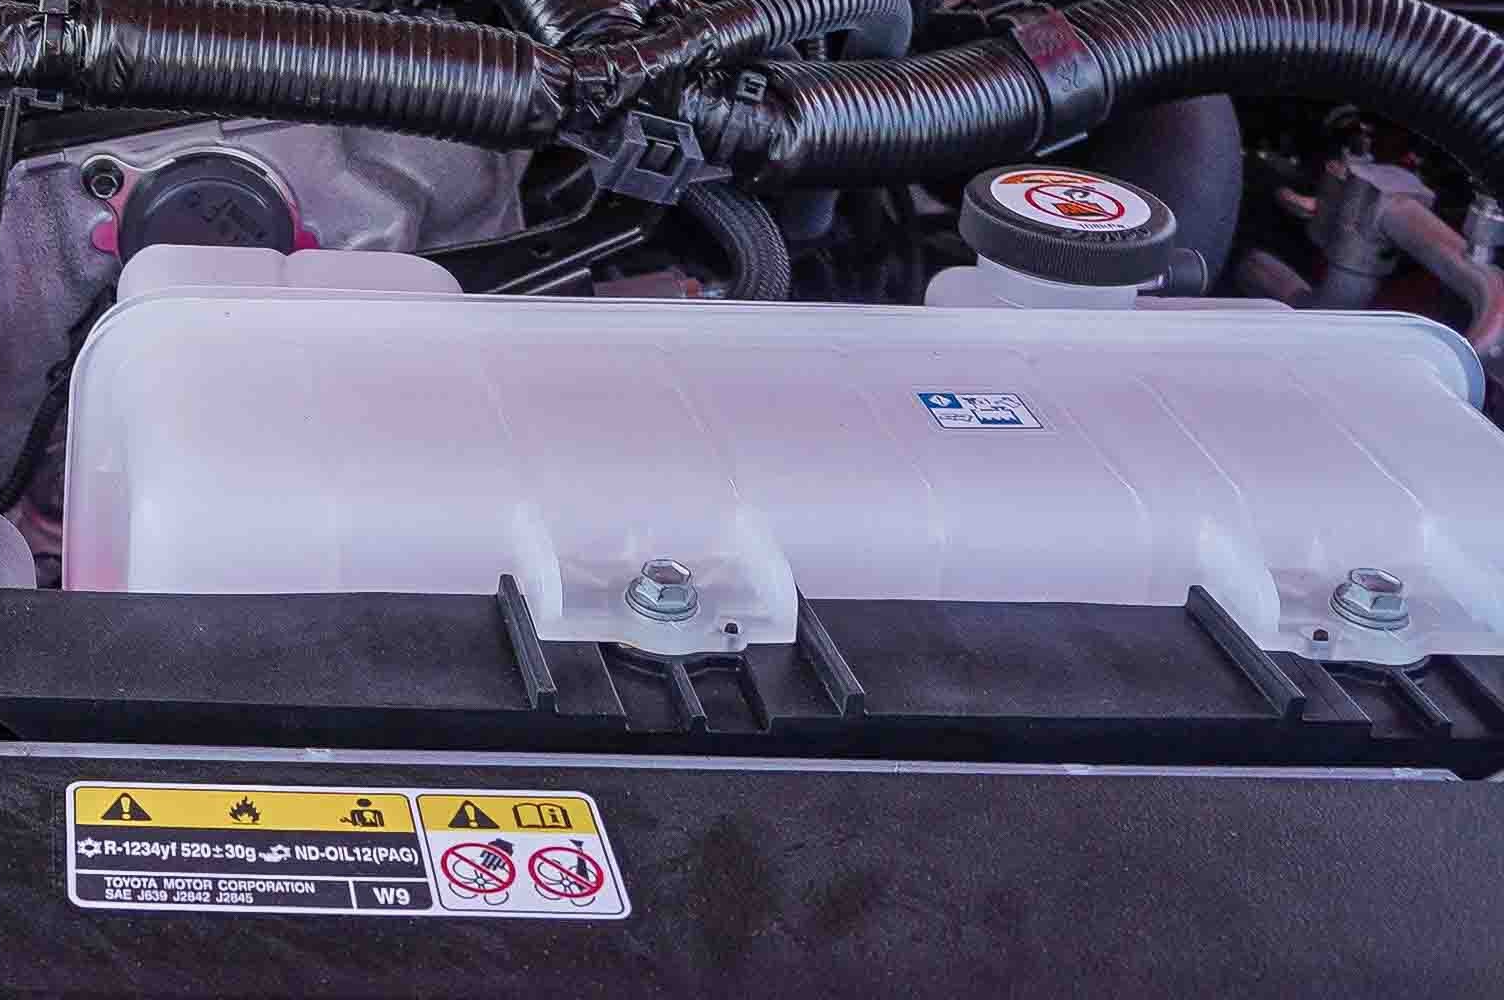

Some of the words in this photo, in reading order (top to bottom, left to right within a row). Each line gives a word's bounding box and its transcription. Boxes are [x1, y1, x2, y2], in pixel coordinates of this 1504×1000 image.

[104, 839, 177, 860] R-1234yf
[181, 842, 257, 862] 520±30g
[294, 845, 419, 865] ND-OIL12(PAG)
[104, 876, 158, 889] TOYOTA
[163, 878, 213, 891] MOTOR
[217, 880, 316, 894] CORPORATION
[104, 888, 132, 900] SAE
[372, 887, 410, 905] W9
